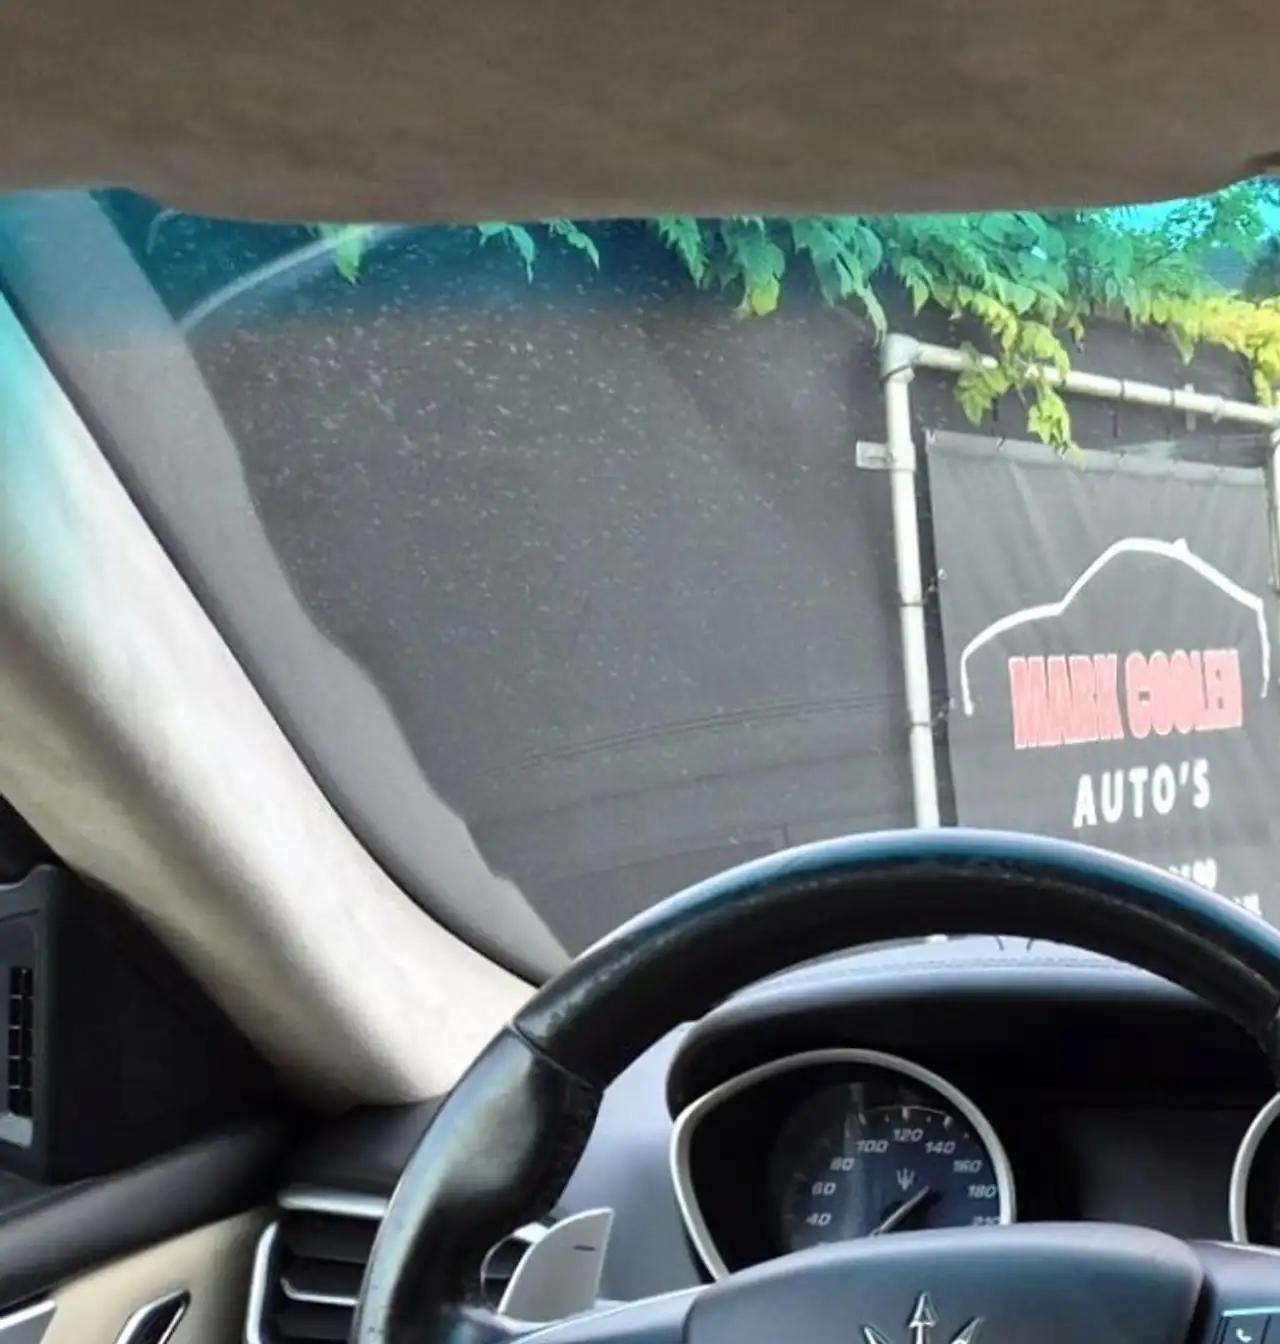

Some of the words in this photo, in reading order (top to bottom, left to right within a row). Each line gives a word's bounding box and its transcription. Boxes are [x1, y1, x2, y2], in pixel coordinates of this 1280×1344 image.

[1008, 653, 1124, 750] MARK
[1073, 758, 1211, 829] AUTO'S
[893, 1128, 924, 1142] 120
[856, 1139, 889, 1153] 100
[925, 1140, 956, 1155] 140
[830, 1157, 855, 1172] 80
[953, 1159, 983, 1174] 160
[811, 1182, 837, 1196] 60
[967, 1184, 997, 1199] 180
[805, 1212, 832, 1226] 40
